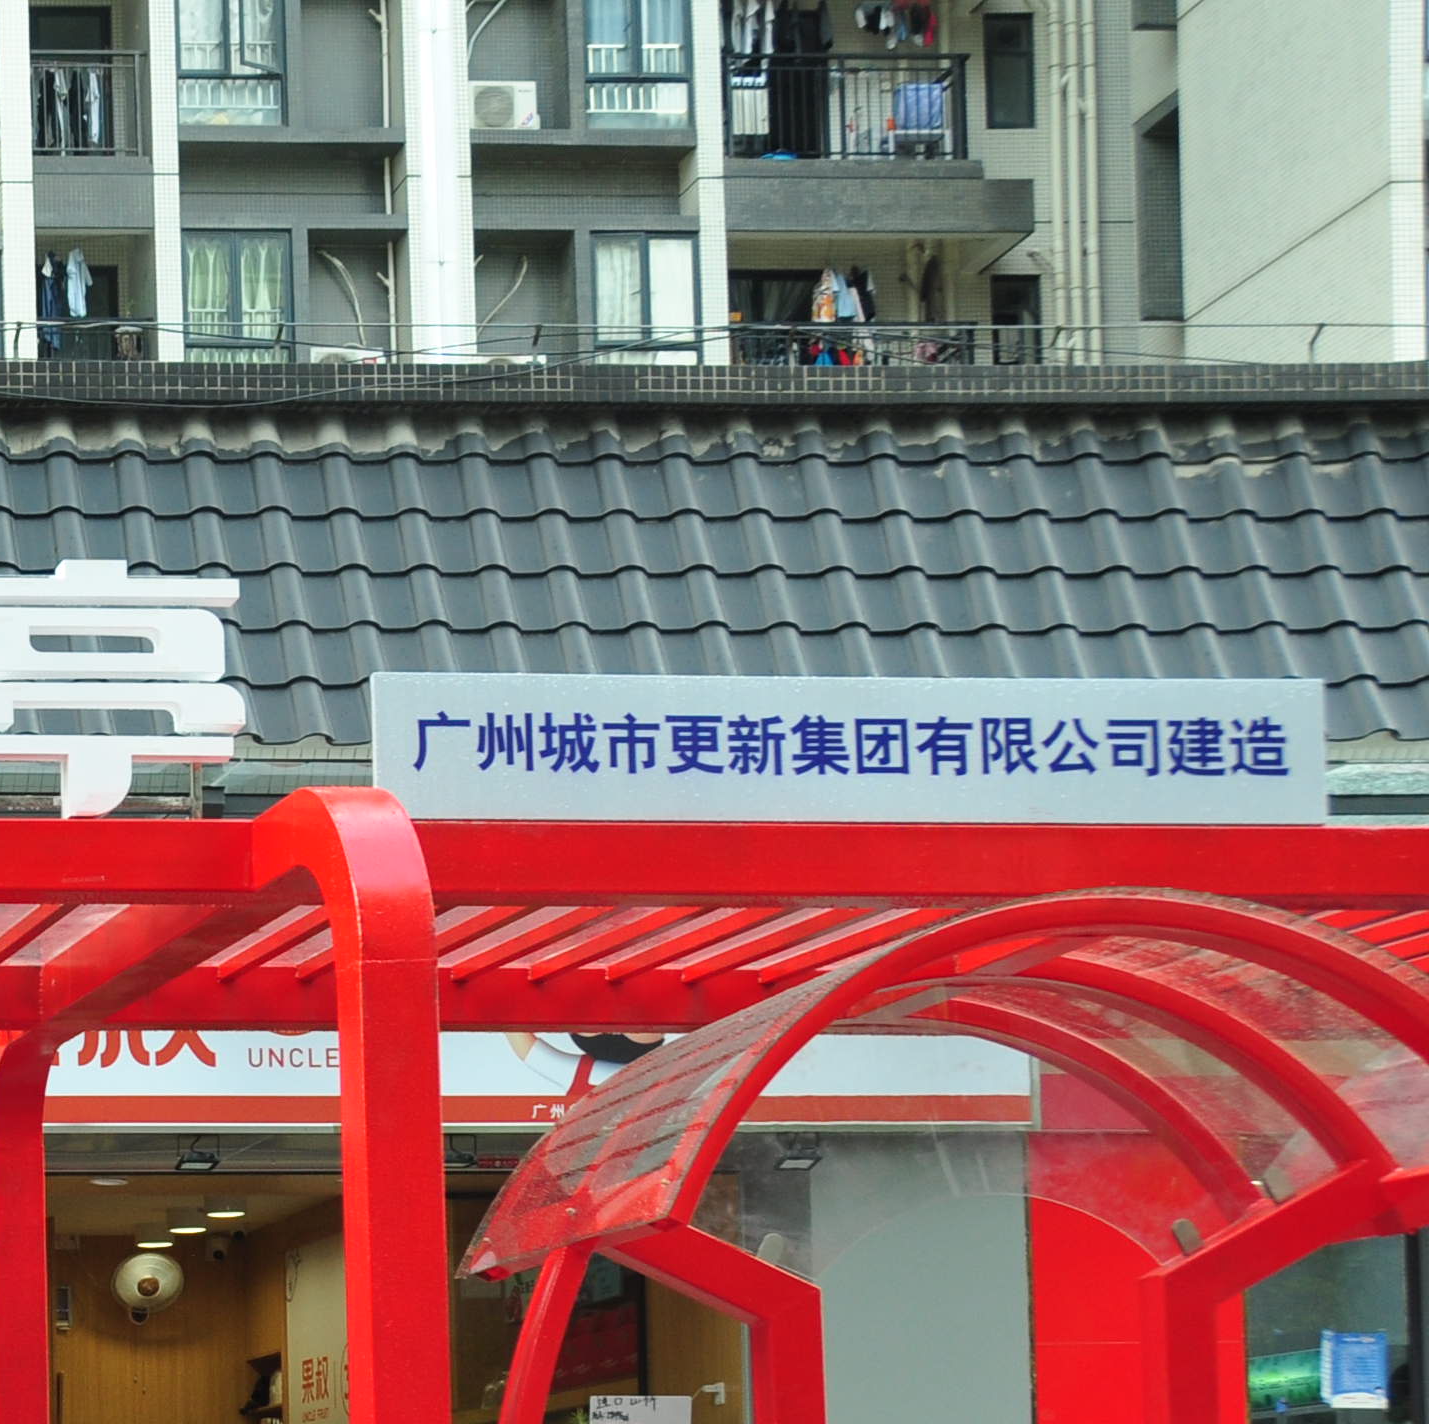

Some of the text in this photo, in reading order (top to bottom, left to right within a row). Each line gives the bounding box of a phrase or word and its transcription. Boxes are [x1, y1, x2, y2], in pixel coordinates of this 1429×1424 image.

[413, 711, 1290, 778] 广州城市更新集团有限公司建造
[248, 1047, 339, 1068] UNCLE
[302, 1356, 329, 1403] 果叔
